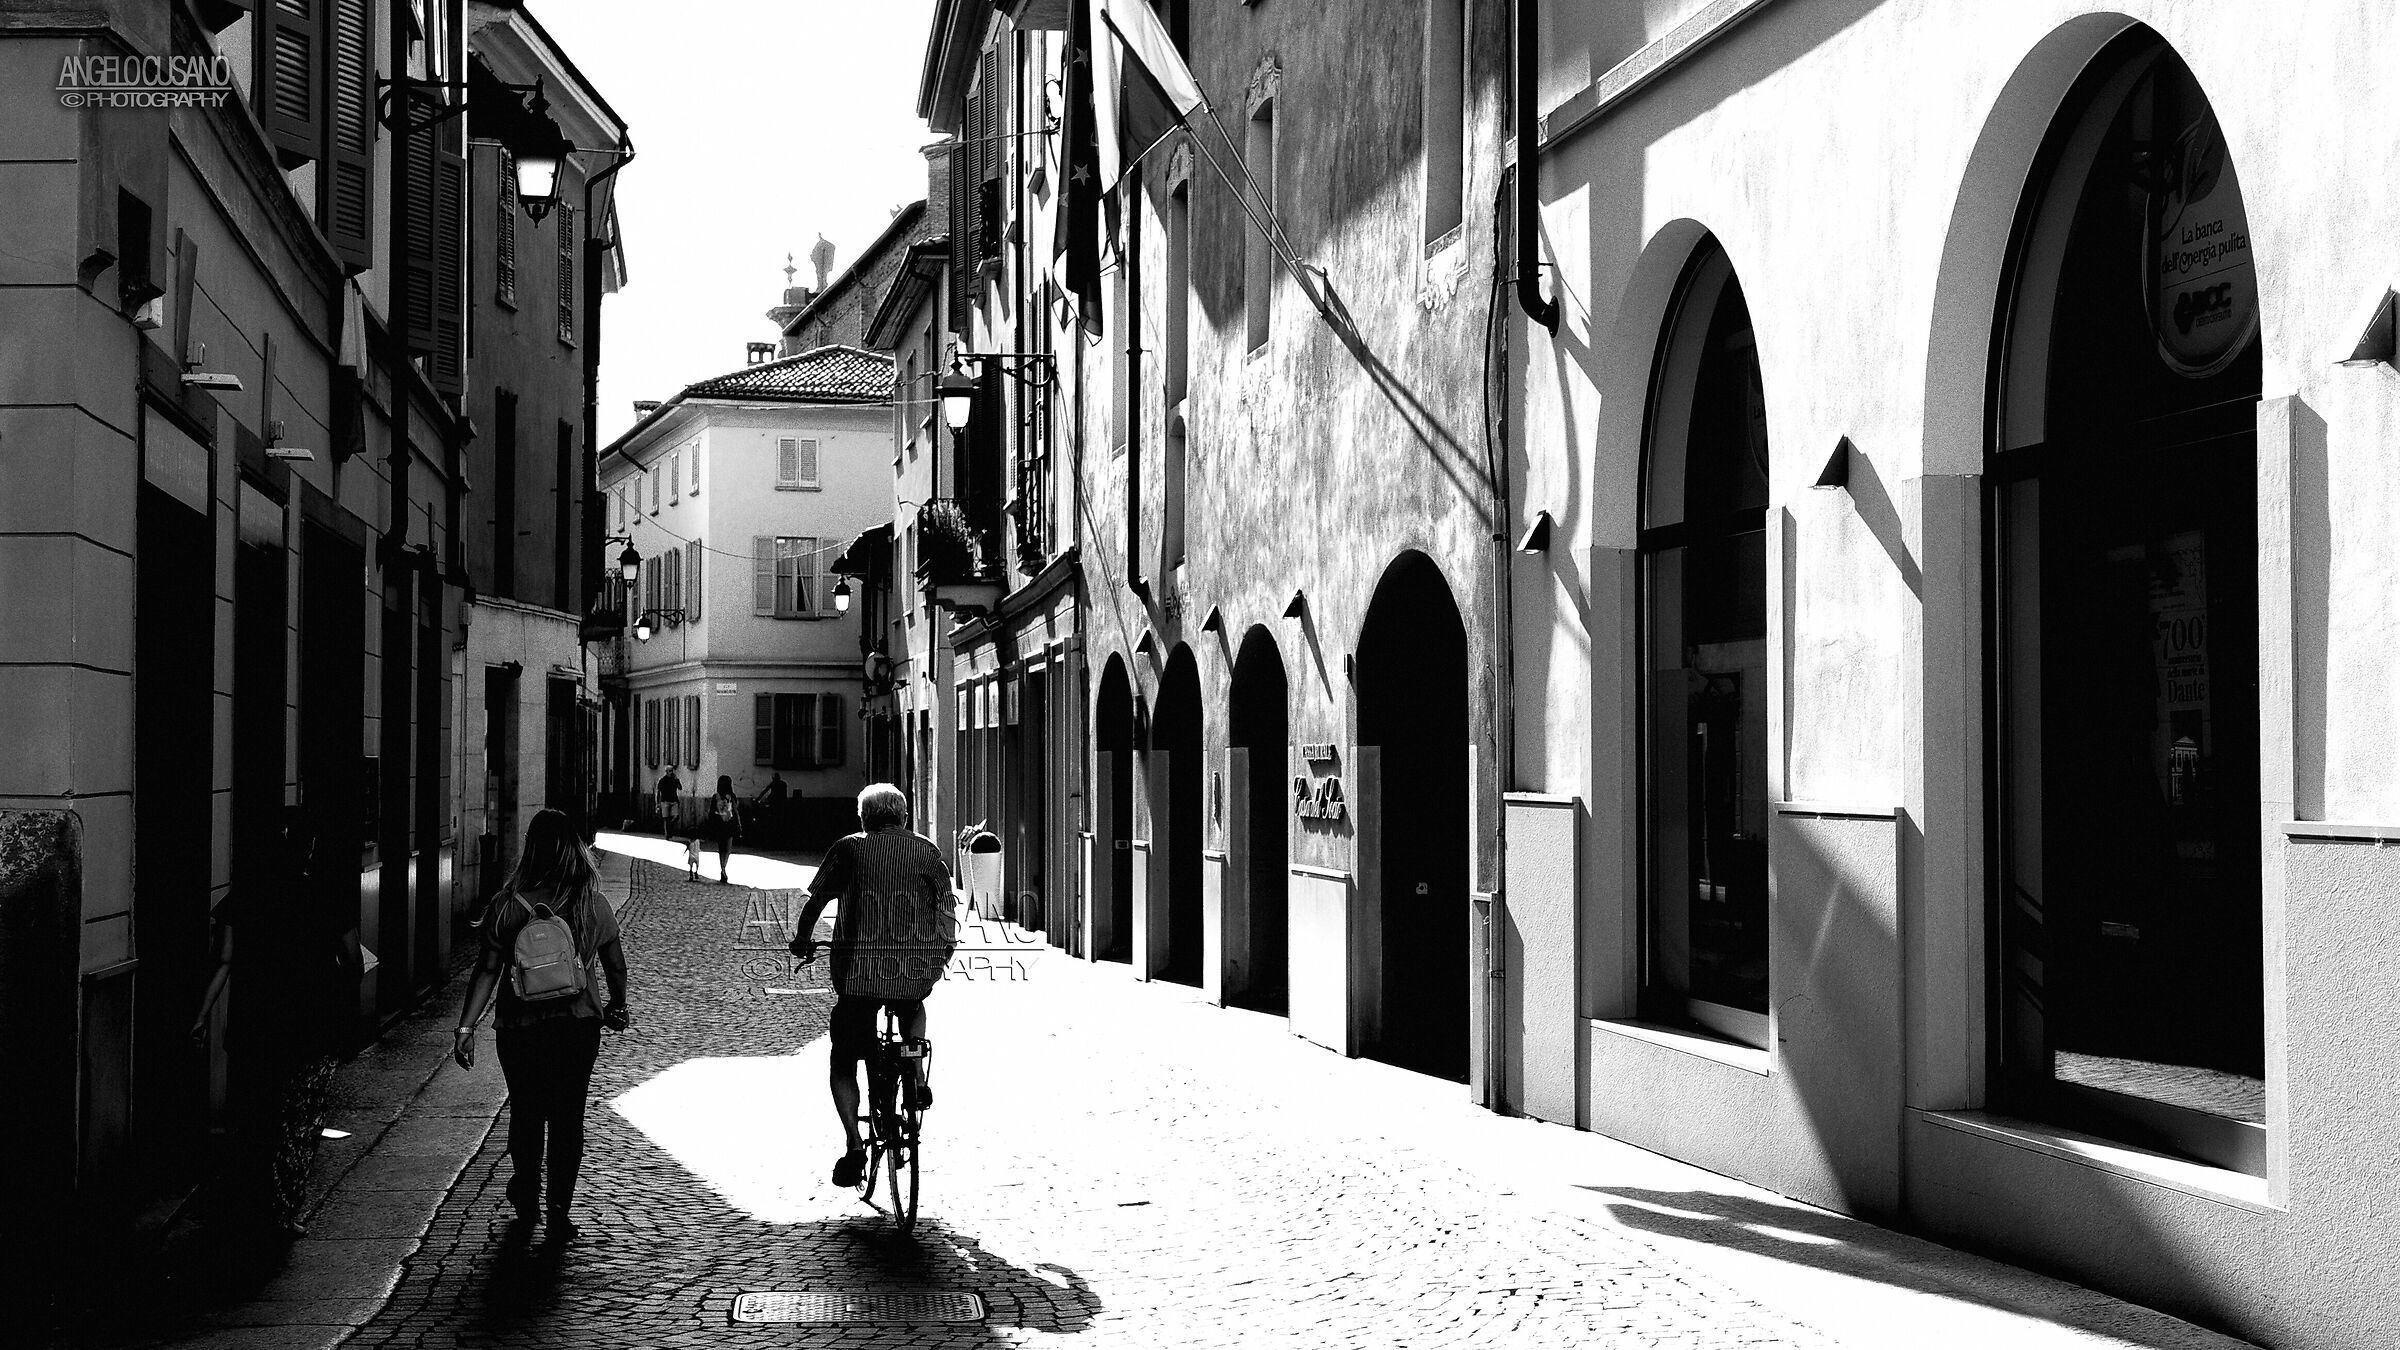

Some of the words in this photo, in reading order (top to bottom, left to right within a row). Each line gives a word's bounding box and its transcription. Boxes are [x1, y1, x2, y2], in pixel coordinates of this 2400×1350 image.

[2182, 227, 2193, 244] La
[2195, 219, 2224, 240] banca
[2219, 232, 2247, 262] pulita
[2167, 679, 2206, 703] Dante
